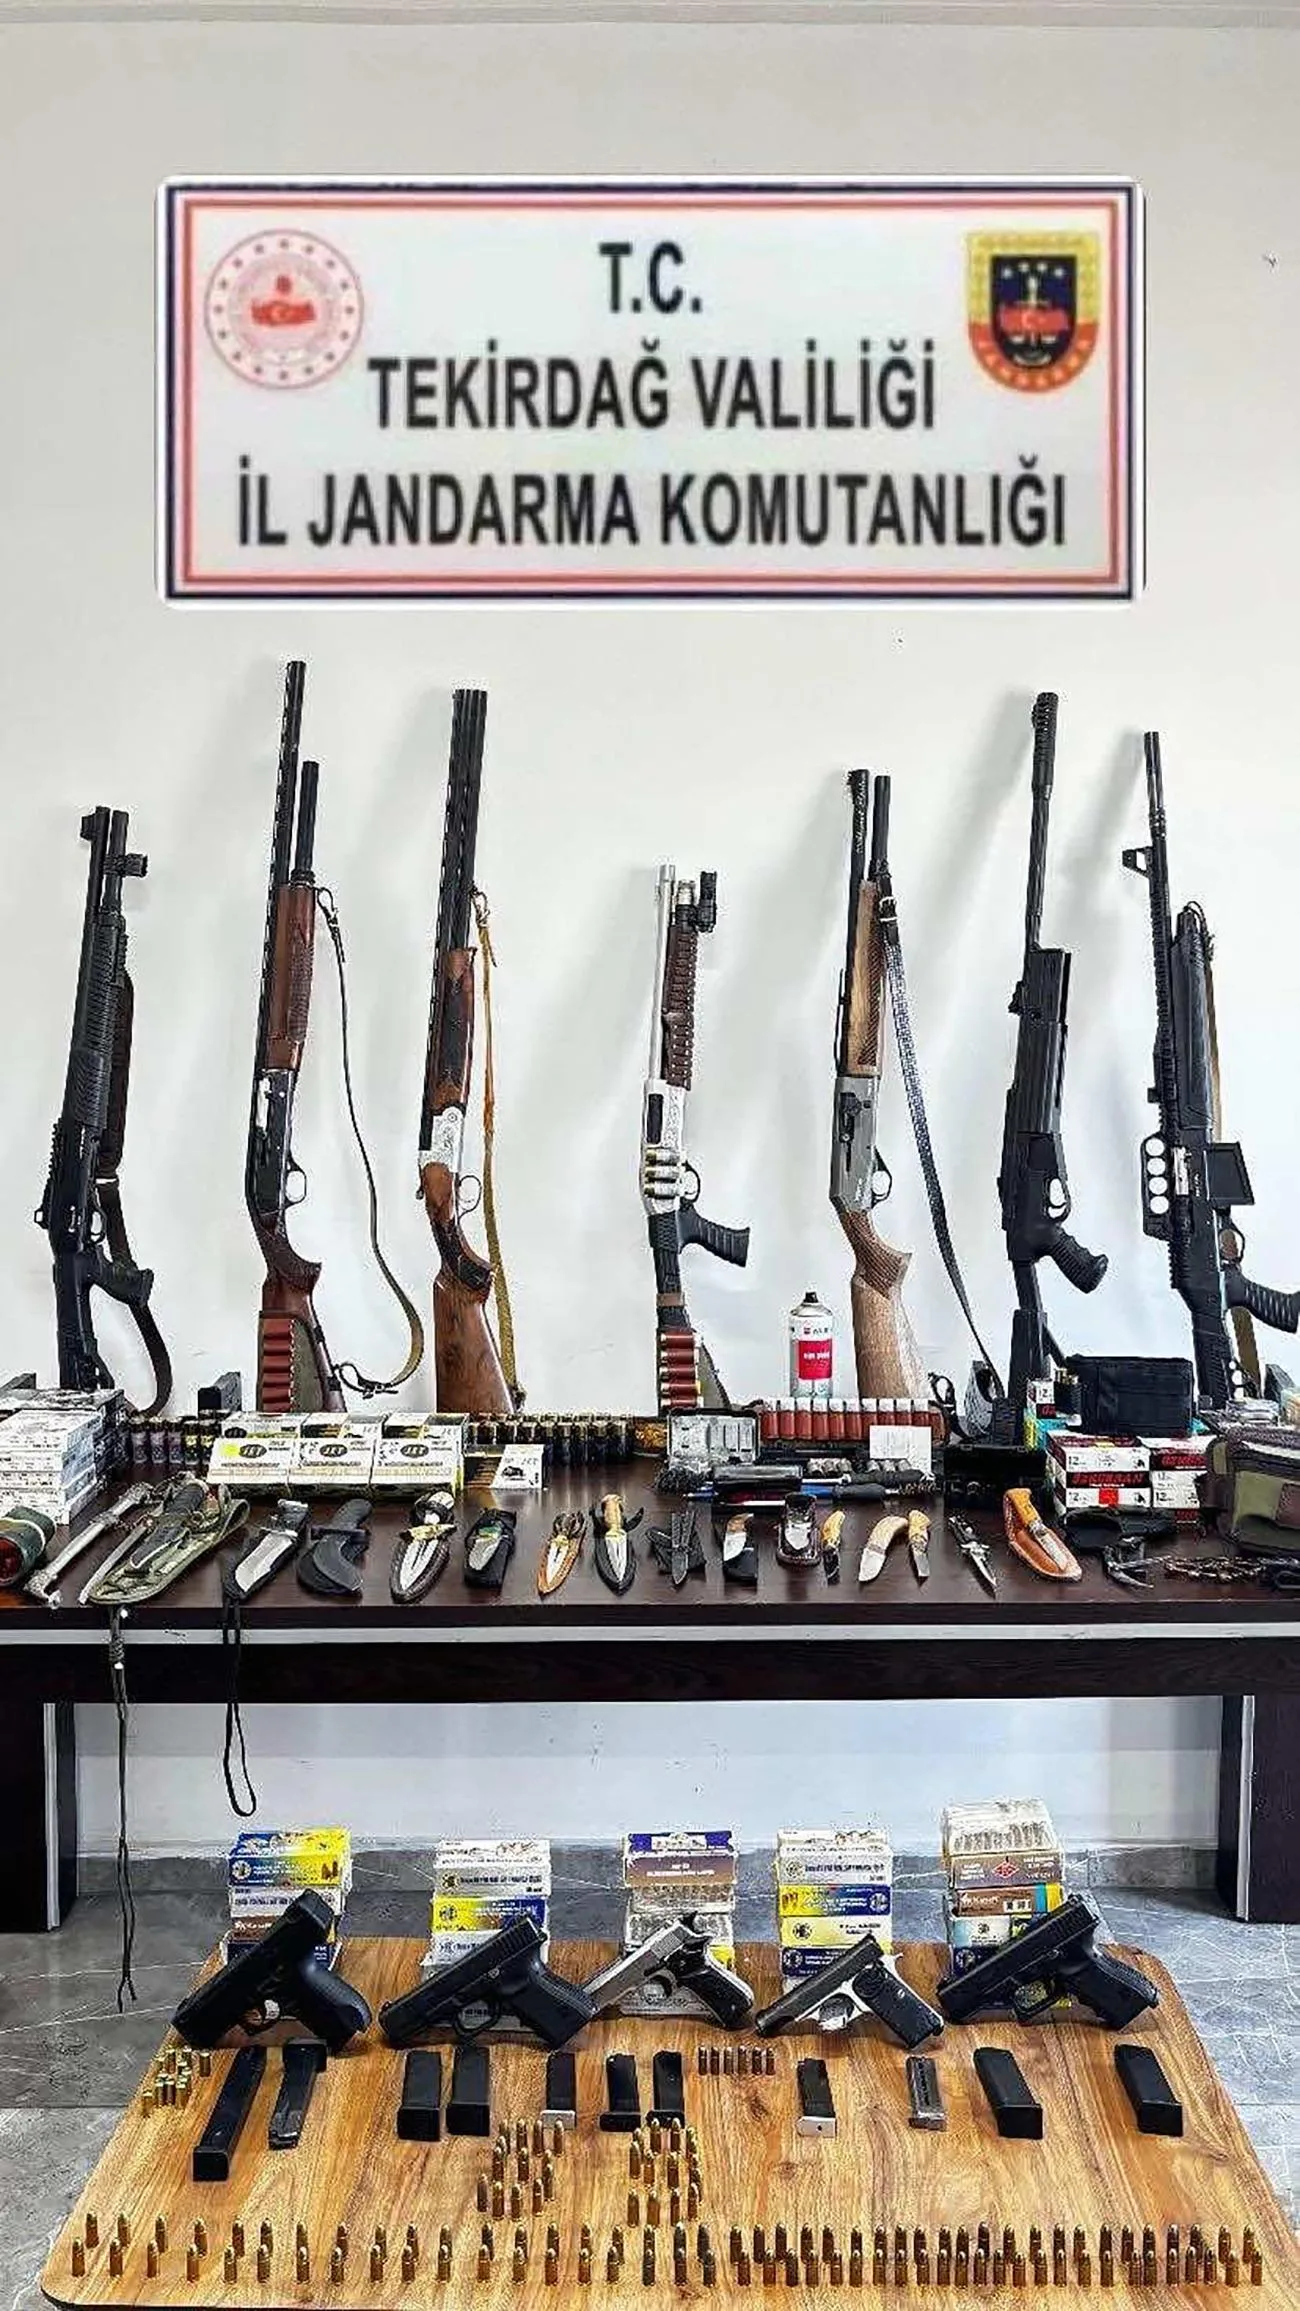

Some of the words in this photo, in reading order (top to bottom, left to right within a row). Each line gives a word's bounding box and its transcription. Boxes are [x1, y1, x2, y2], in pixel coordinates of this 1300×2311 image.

[599, 242, 702, 314] T.C.
[368, 338, 668, 430] TEKİRDAĞ
[691, 338, 935, 430] VALİLİĞİ
[239, 455, 287, 546] İL
[308, 472, 639, 547] JANDARMA
[661, 455, 1065, 547] KOMUTANLIĞI
